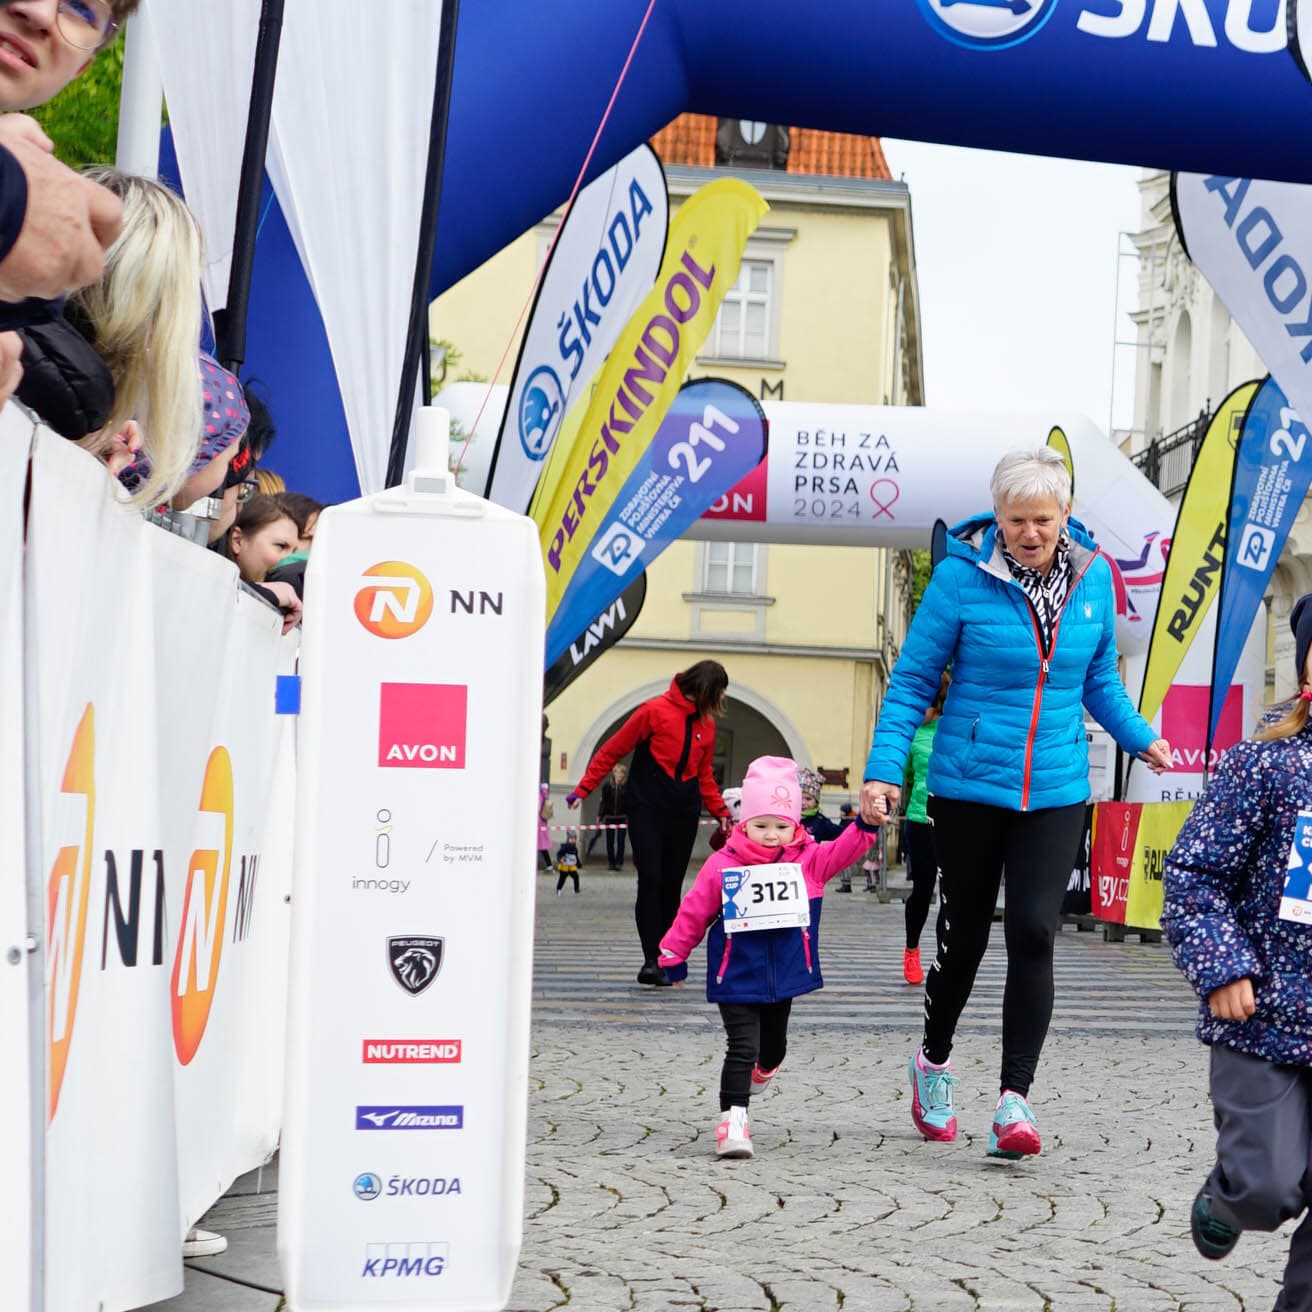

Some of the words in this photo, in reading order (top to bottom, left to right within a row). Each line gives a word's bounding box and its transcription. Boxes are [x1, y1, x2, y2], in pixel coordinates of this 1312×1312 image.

[557, 177, 653, 382] ŠKODA
[547, 249, 716, 576] PERSKINDOL
[668, 404, 740, 483] 211
[797, 429, 846, 447] BĚH
[859, 433, 890, 449] ZA
[795, 452, 900, 473] ZDRAVÁ
[795, 475, 859, 495] PRSA
[709, 493, 753, 514] ON
[793, 498, 863, 519] 2024
[1166, 522, 1228, 644] RUNT
[449, 589, 503, 616] NN
[569, 595, 627, 666] LAWI
[386, 744, 457, 762] AVON
[443, 843, 484, 853] Powered
[443, 854, 456, 864] by
[458, 855, 483, 863] MVM
[351, 875, 411, 894] innogy
[751, 880, 799, 904] 3121
[391, 940, 441, 948] PEUGEOT
[367, 1044, 458, 1059] NUTREND
[386, 1175, 462, 1196] ŠKODA
[361, 1256, 446, 1278] KPMG
